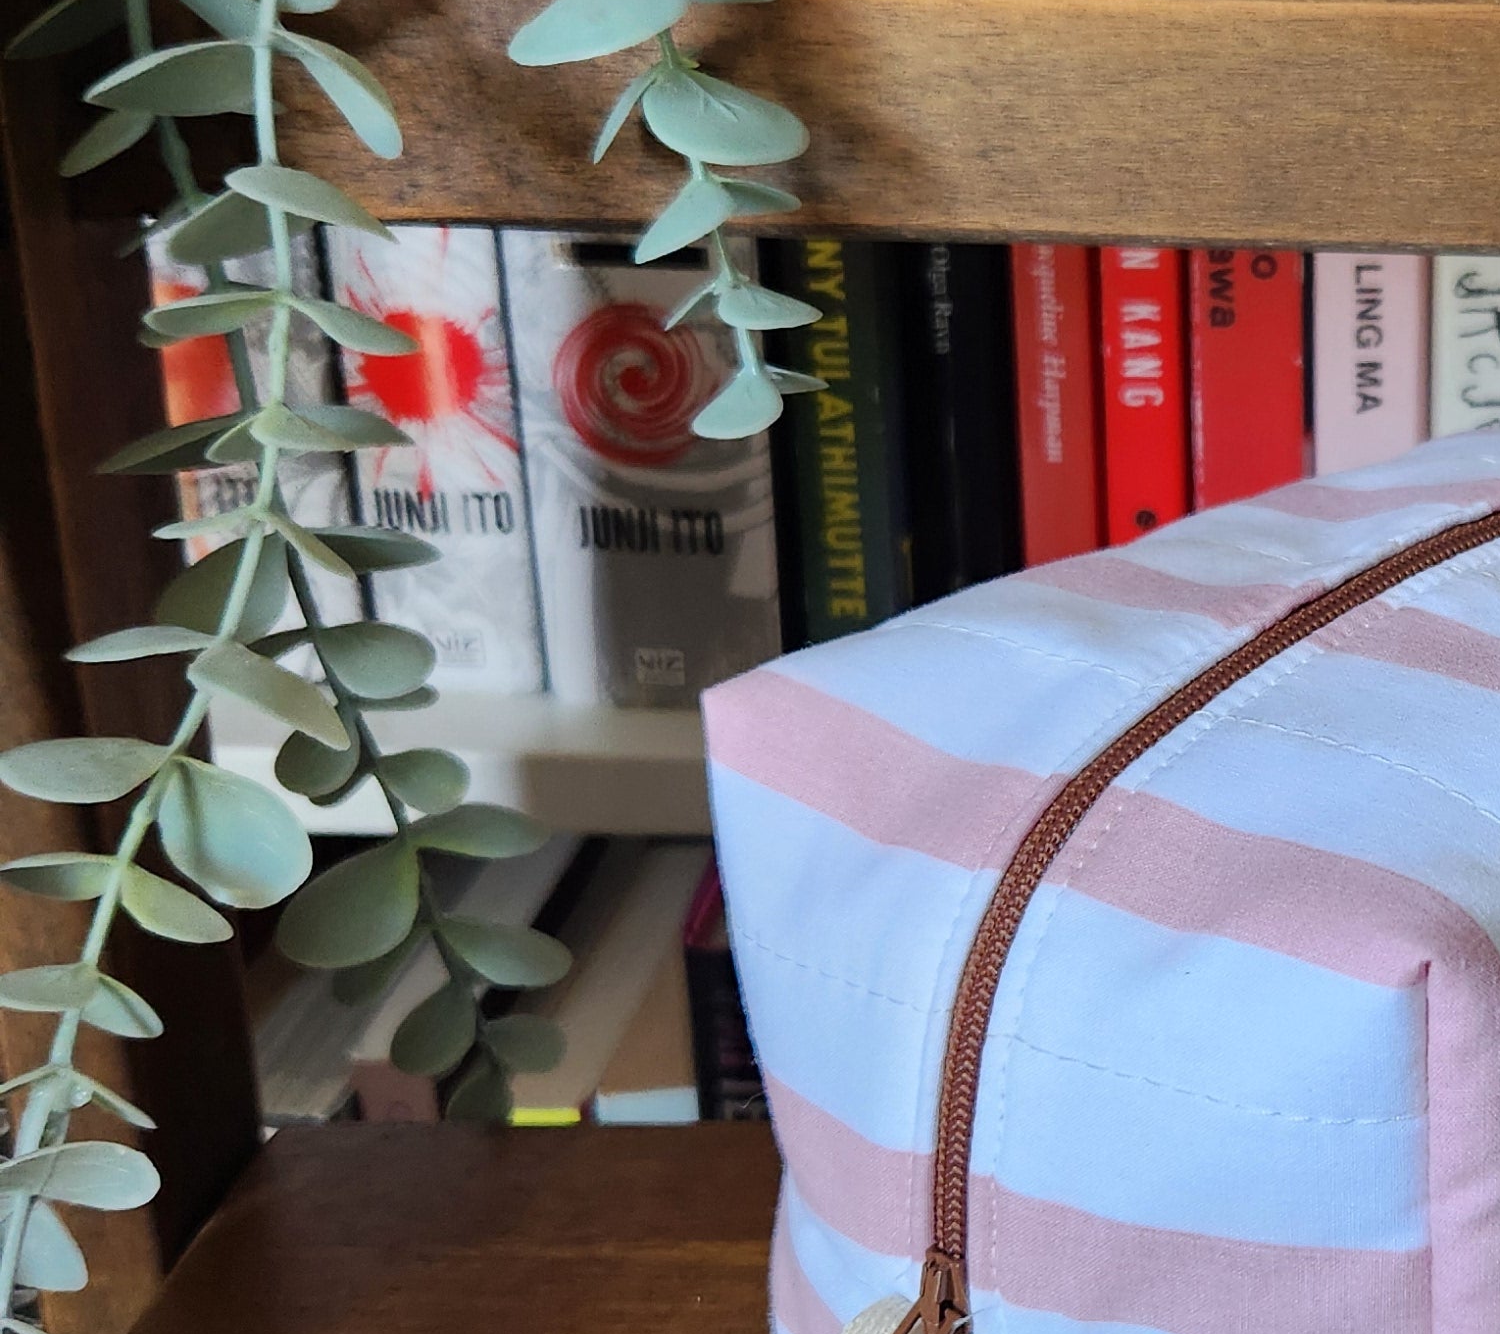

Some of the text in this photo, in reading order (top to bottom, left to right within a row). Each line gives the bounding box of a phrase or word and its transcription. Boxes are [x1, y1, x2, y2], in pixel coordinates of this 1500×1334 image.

[1118, 303, 1165, 409] KANG
[1354, 264, 1384, 415] LING MA
[375, 489, 515, 535] JUNJI ITO
[811, 315, 866, 619] TULATHIMUTTE
[578, 507, 724, 556] JUNJI ITO
